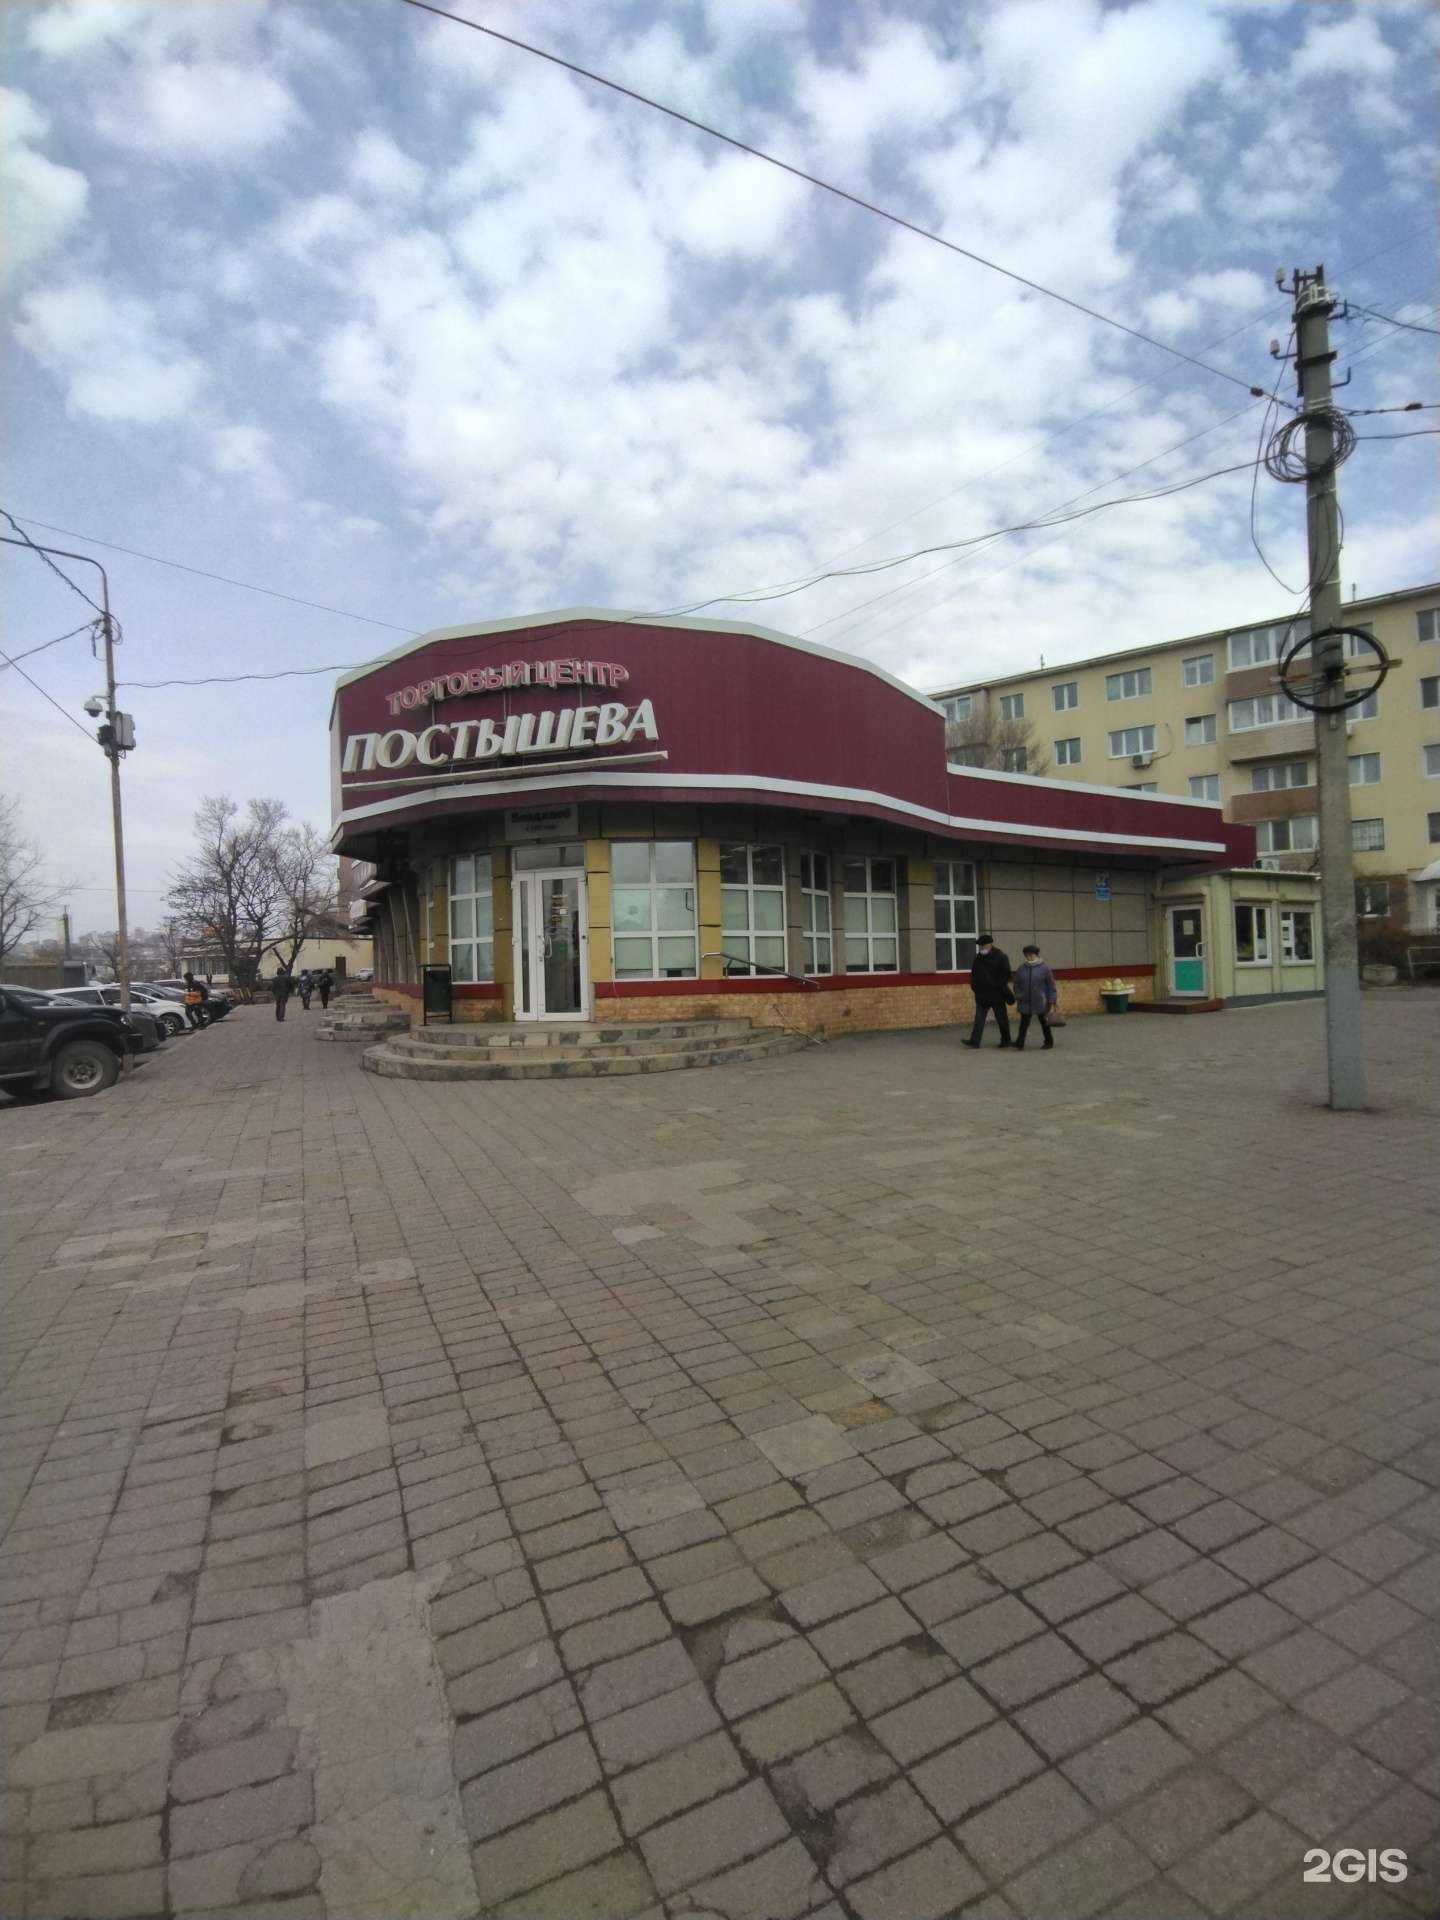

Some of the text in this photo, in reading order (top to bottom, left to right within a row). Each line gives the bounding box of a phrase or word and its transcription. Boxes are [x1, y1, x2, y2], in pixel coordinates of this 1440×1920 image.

[385, 658, 630, 716] ТОРГОВЫЙ ЦЕНТР
[342, 698, 659, 773] ПОСТЫШЕВА
